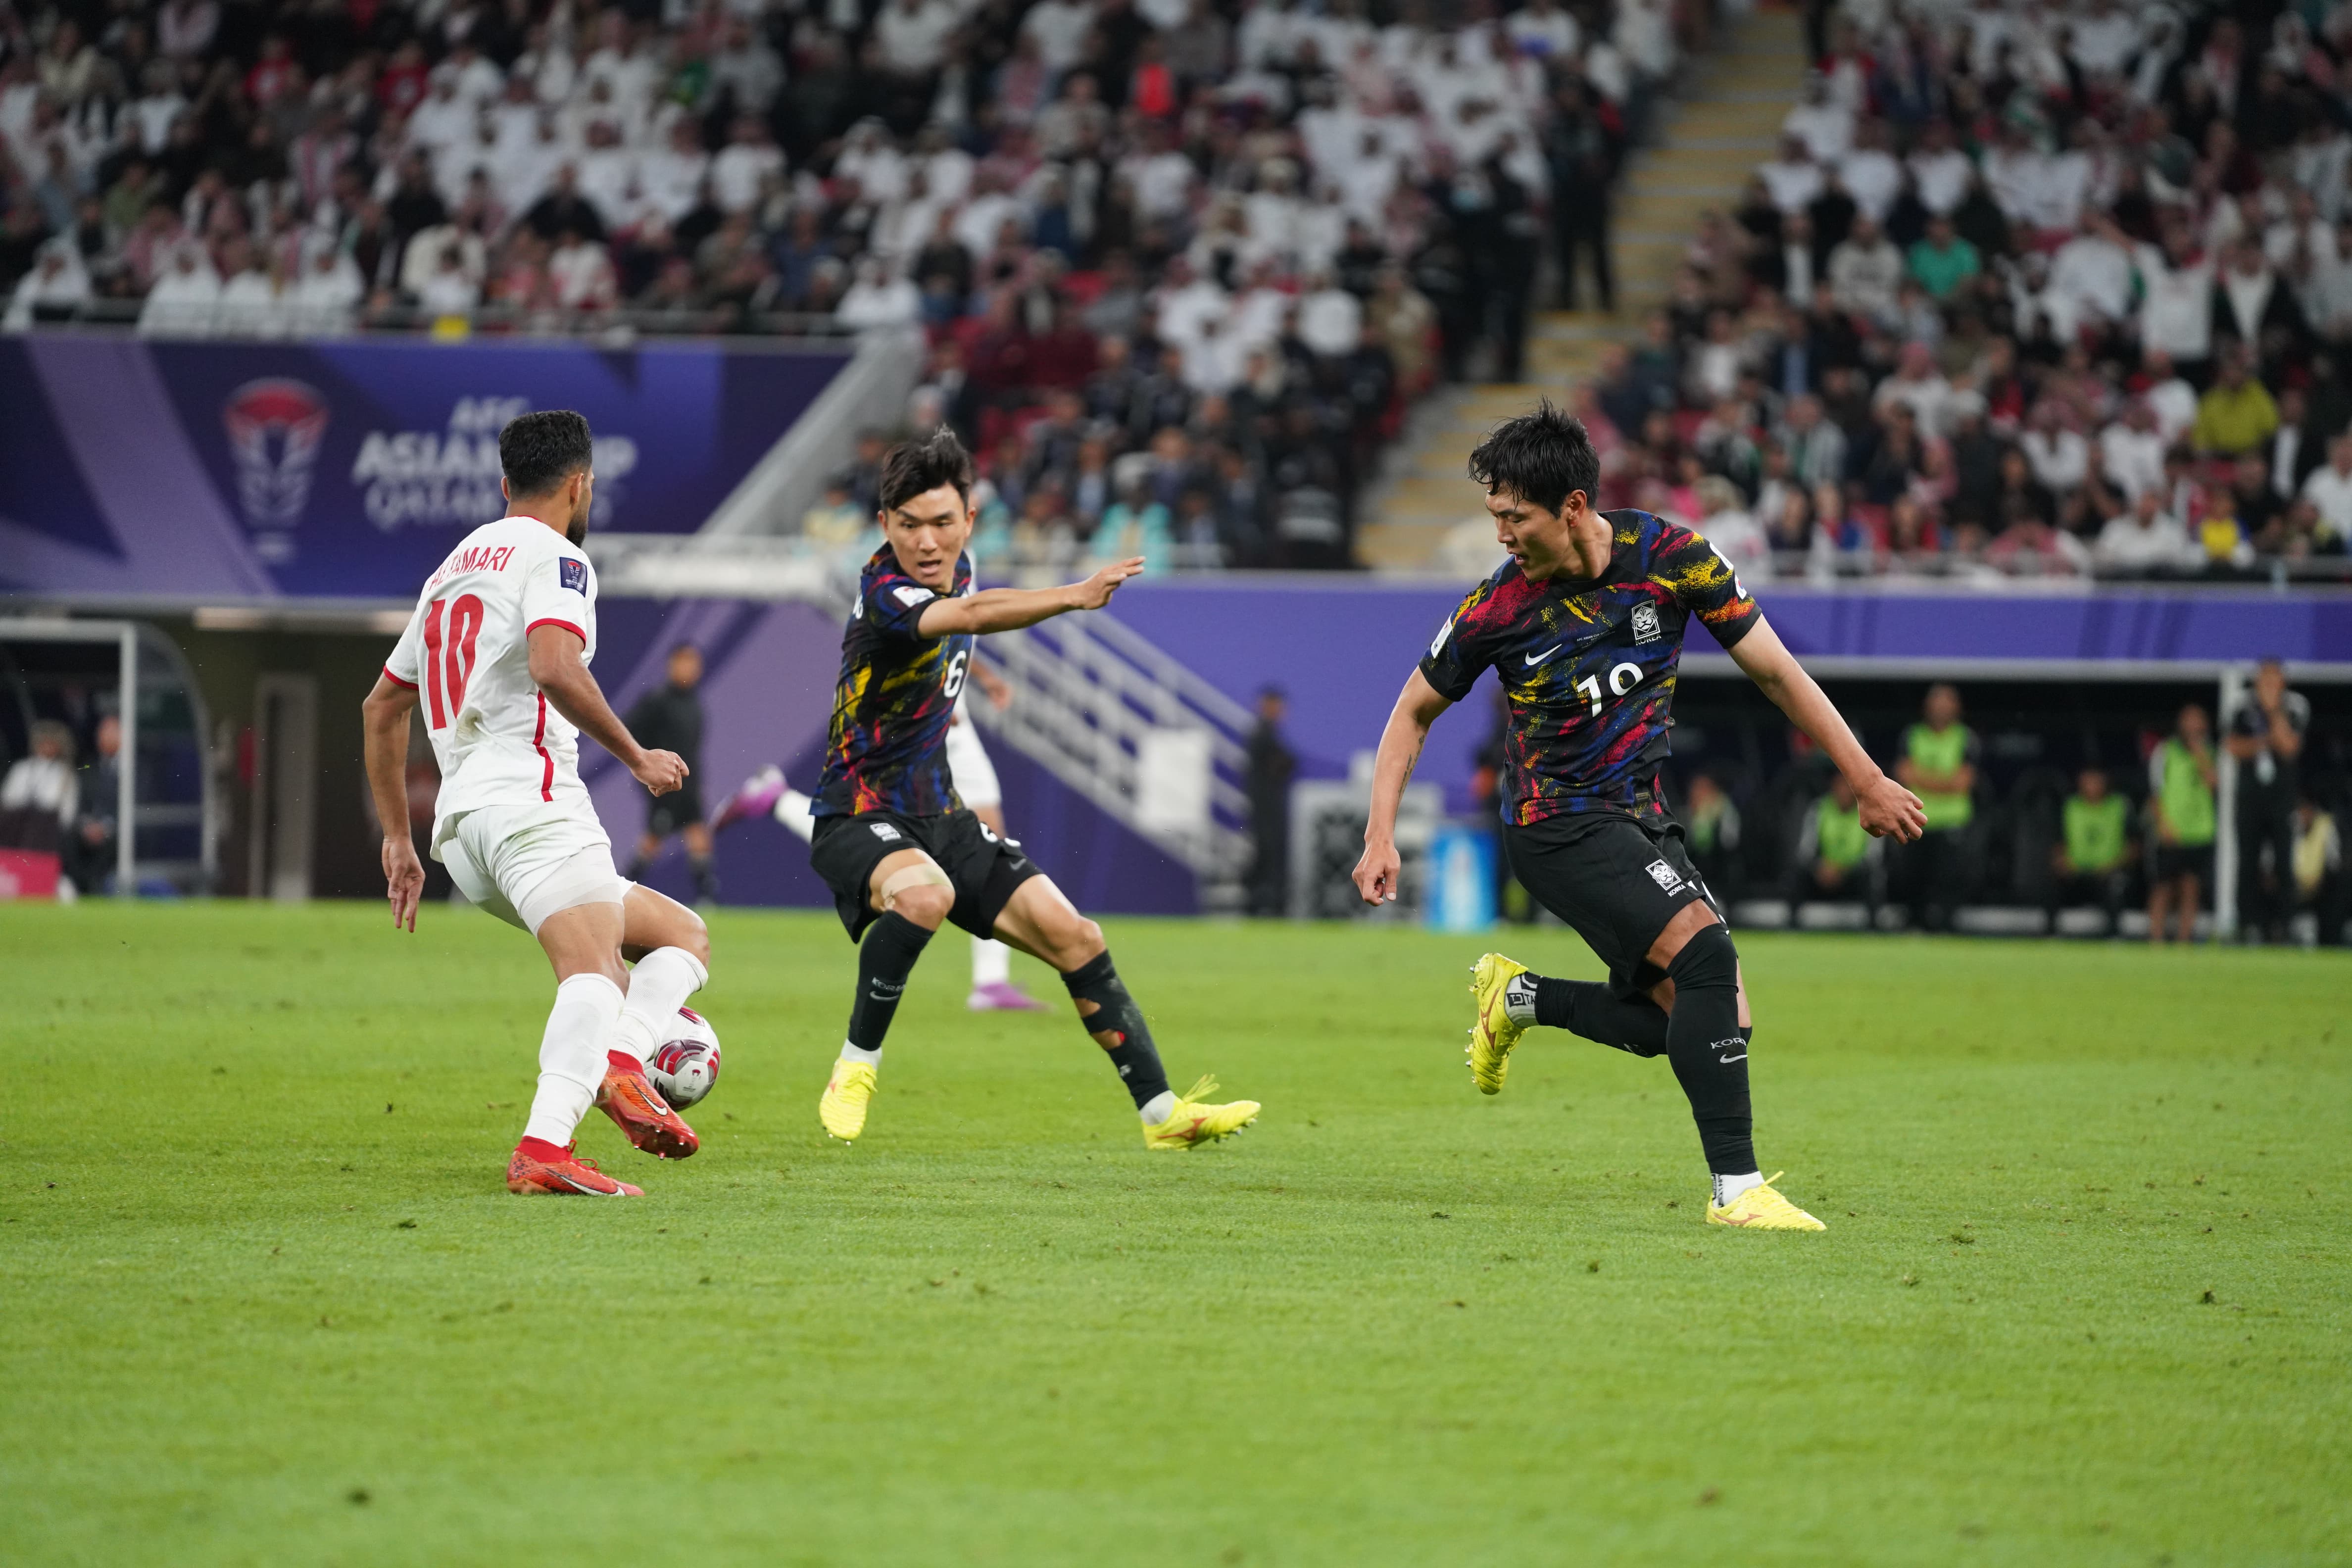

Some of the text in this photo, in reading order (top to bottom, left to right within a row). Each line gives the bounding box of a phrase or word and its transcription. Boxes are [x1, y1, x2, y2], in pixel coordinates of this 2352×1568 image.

[1635, 634, 1662, 646] KOREA
[424, 593, 484, 730] 10
[943, 650, 967, 698] 6
[1667, 884, 1686, 897] KOREA
[1710, 1037, 1747, 1049] KOR
